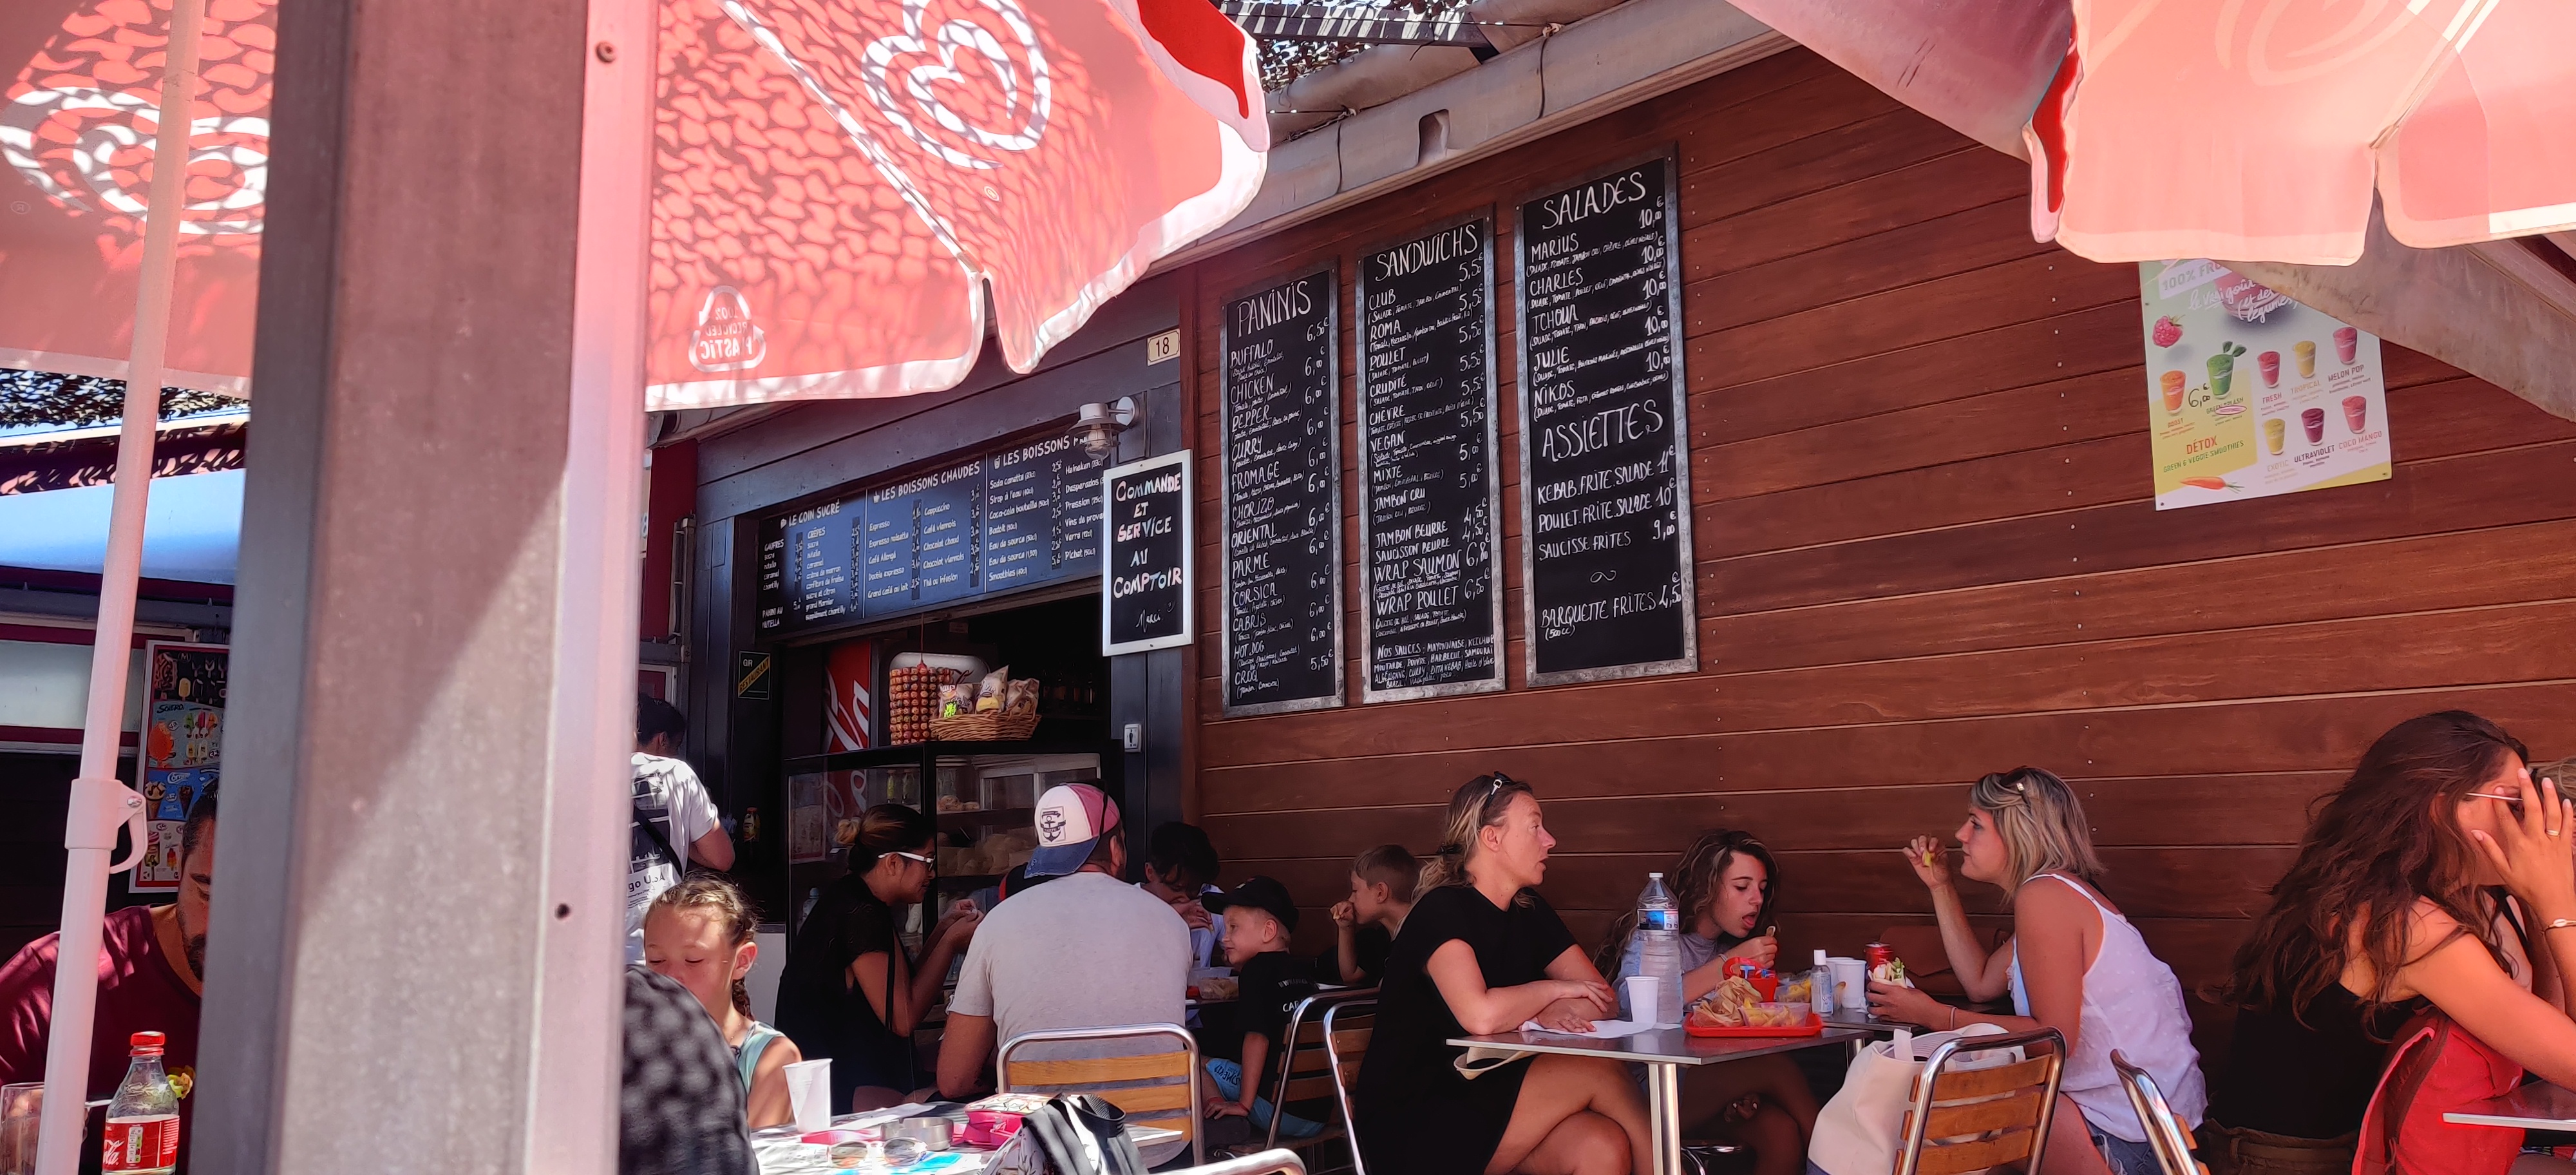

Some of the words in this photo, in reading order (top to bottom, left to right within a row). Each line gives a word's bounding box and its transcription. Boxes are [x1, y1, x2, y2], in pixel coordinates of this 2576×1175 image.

[1542, 171, 1645, 230] SALADES
[1375, 224, 1478, 281] SANDWICHS
[1531, 233, 1578, 263] MARIUS
[1530, 267, 1583, 296] CHARLES
[2162, 269, 2196, 290] 100%
[1237, 281, 1311, 338] PANINIS
[1368, 289, 1396, 310] CLUB
[1370, 320, 1401, 342] ROMA
[1156, 337, 1170, 357] 18
[1229, 339, 1273, 369] BUFFALO
[1369, 347, 1406, 372] POULET
[1533, 345, 1570, 372] JULIE
[1370, 372, 1407, 397] CRUDITÉ
[2328, 369, 2350, 383] MELON
[2351, 364, 2364, 375] POP
[1230, 372, 1275, 405] CHICKEN
[1533, 380, 1575, 408] NIKOS
[2262, 392, 2282, 405] FRESH
[2290, 380, 2320, 394] TROPICAL
[1231, 404, 1271, 434] PEPPER
[1542, 399, 1663, 462] ASSIETTES
[1003, 450, 1019, 466] LES
[1023, 435, 1070, 462] BOISSONS
[1231, 435, 1263, 463] CURRY
[1370, 430, 1406, 452] VEGAN
[2186, 435, 2218, 455] DÉTOX
[2338, 439, 2356, 450] COCO
[2358, 430, 2382, 443] MANGO
[2163, 461, 2181, 473] GREEN
[2210, 440, 2244, 457] SMOOTHIES
[2267, 460, 2289, 472] EXOTIC
[2294, 445, 2335, 463] ULTRAVIOLET
[881, 486, 896, 501] LES
[898, 473, 938, 497] BOISSONS
[941, 461, 980, 484] CHAUDES
[1065, 477, 1099, 494] Desperados
[1115, 472, 1181, 502] COMMANDE
[1231, 461, 1280, 493] FROMAGE
[1374, 465, 1403, 483] MIXTE
[788, 515, 797, 527] LE
[799, 508, 815, 524] COIN
[817, 499, 840, 519] SUCRÉ
[1065, 499, 1090, 511] Pression
[1133, 501, 1149, 518] ET
[1233, 497, 1274, 522] CHORIZO
[1374, 490, 1408, 512] JAMBON
[1410, 488, 1426, 501] CRU
[1117, 516, 1172, 542] SERVICE
[1231, 522, 1278, 548] ORIENTAL
[1375, 525, 1413, 548] JAMBON
[1414, 521, 1448, 539] BEURRE
[764, 539, 784, 551] GAUFRES
[1130, 548, 1148, 567] AU
[1375, 543, 1419, 564] SAUCISSON
[1422, 537, 1451, 554] BEURRE
[1539, 537, 1590, 561] SAUCISSE
[1593, 531, 1631, 551] FRITES
[1233, 552, 1271, 579] PARME
[1374, 560, 1409, 583] WRAP
[1413, 549, 1462, 577] SAUMON
[1113, 567, 1182, 598] COMPTOIR
[1233, 582, 1278, 607] CORSICA
[1376, 593, 1412, 616] WRAP
[1416, 586, 1459, 611] POULET
[1540, 600, 1609, 628] BARQUETTE
[1613, 591, 1656, 618] FRITES
[762, 617, 780, 629] NUTELLA
[1233, 612, 1267, 631] CABRIS
[1233, 643, 1249, 660] HOT
[1249, 640, 1265, 656] DOG
[1377, 644, 1392, 660] NOS
[1468, 635, 1494, 647] KETCHUP
